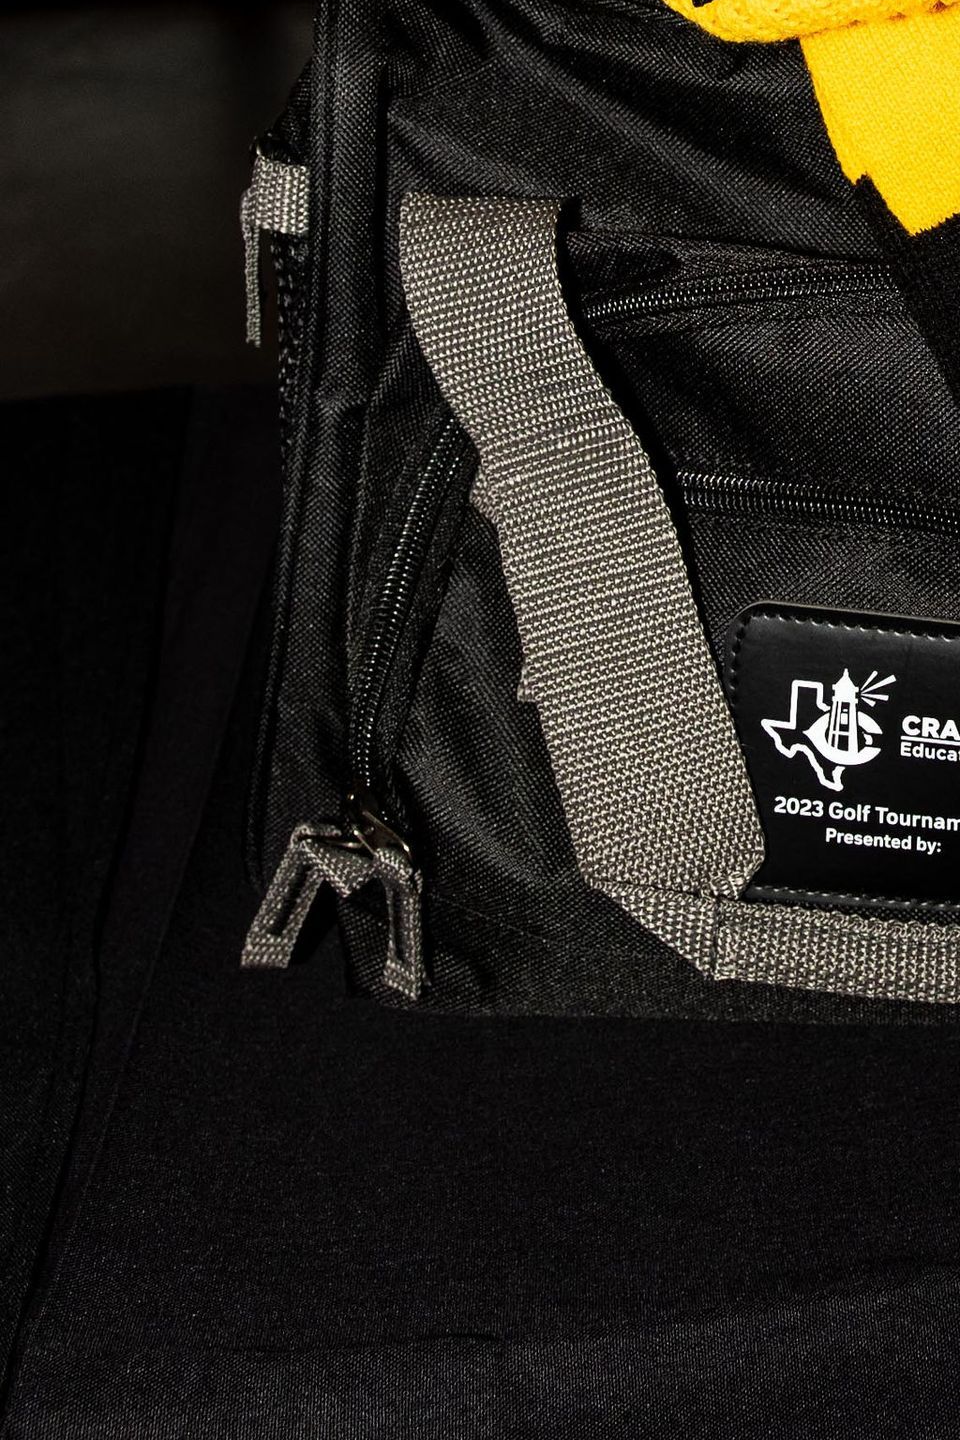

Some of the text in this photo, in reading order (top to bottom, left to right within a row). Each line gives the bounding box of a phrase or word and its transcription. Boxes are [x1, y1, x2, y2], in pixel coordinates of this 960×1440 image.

[773, 795, 825, 818] 2023
[828, 801, 871, 823] Golf
[825, 827, 943, 857] Presented by:
